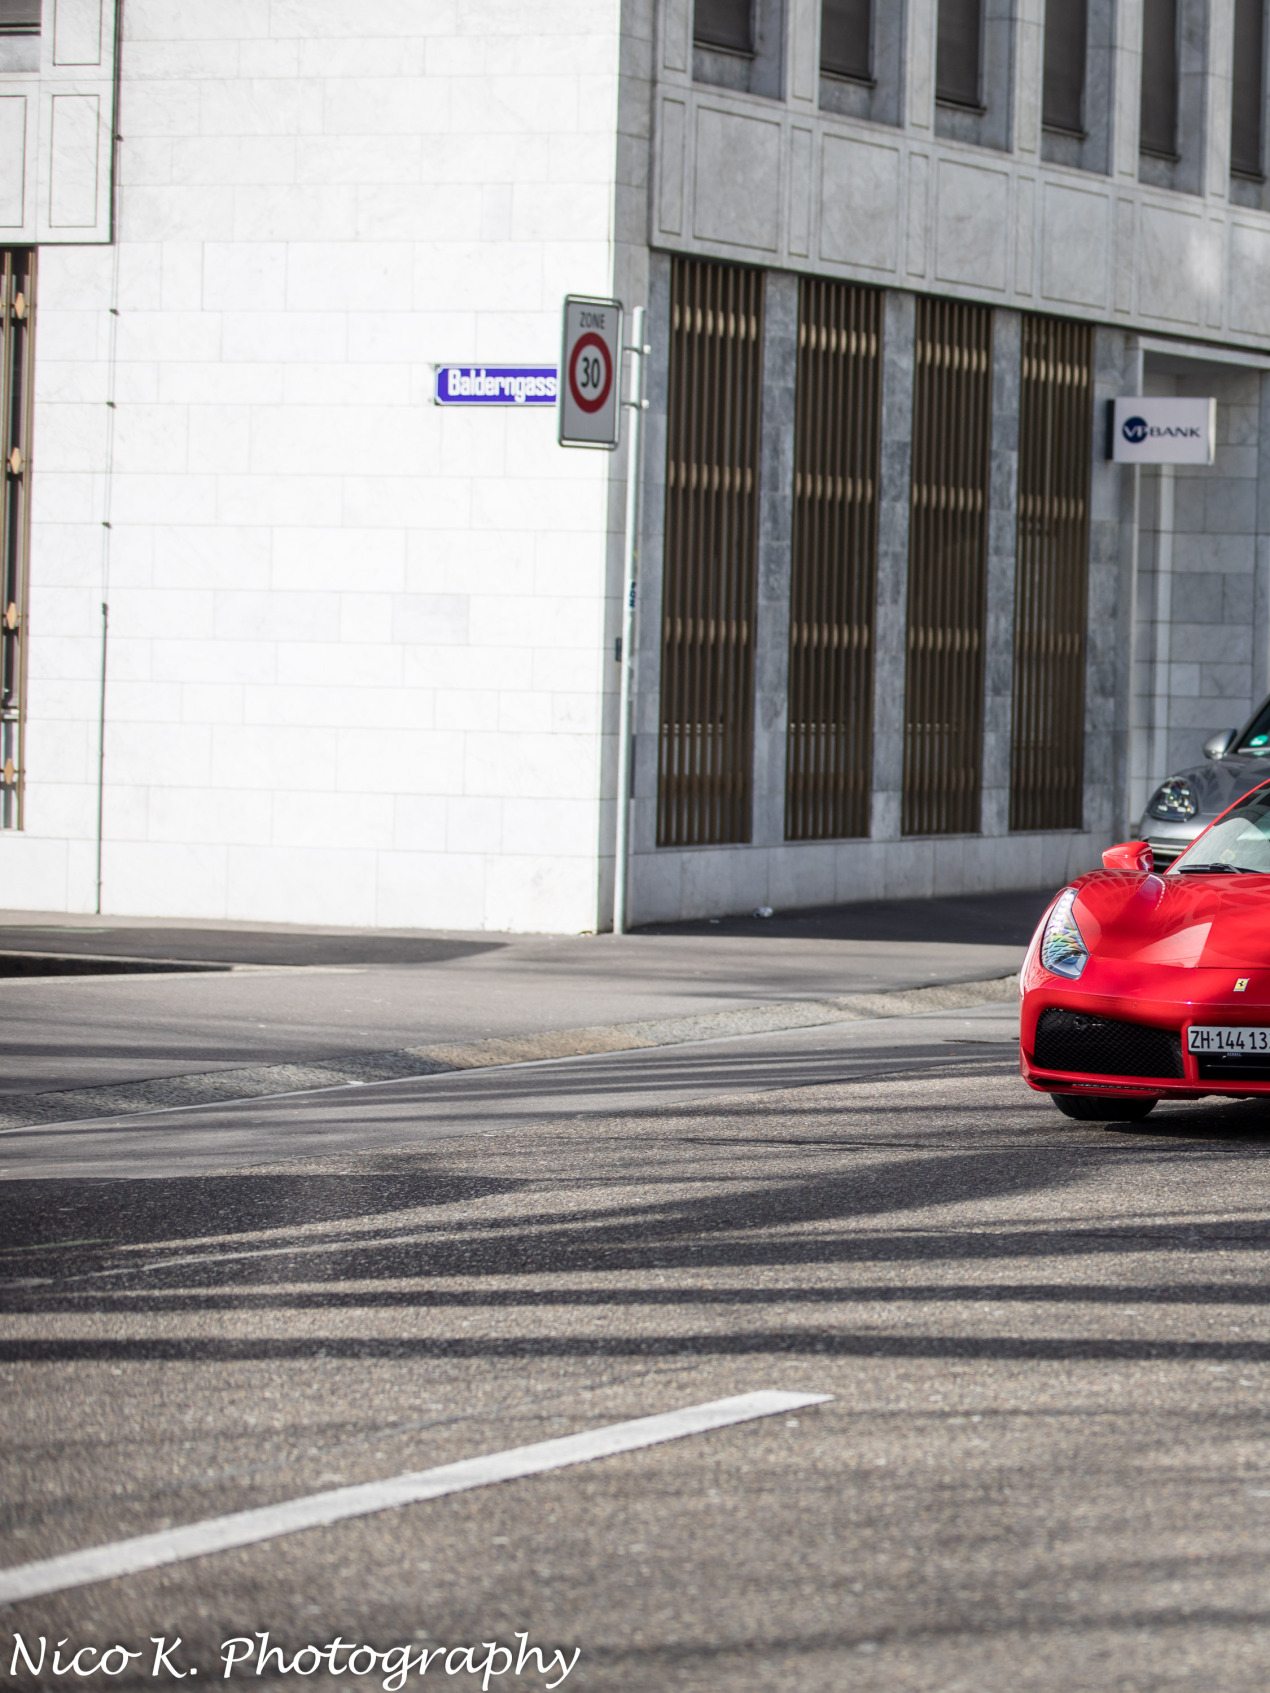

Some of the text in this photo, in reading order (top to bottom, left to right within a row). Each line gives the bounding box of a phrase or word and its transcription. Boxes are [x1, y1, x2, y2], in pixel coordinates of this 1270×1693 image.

[579, 311, 606, 330] ZONE
[581, 356, 601, 389] 30
[447, 369, 557, 403] Balderngass
[1150, 426, 1201, 438] BANK
